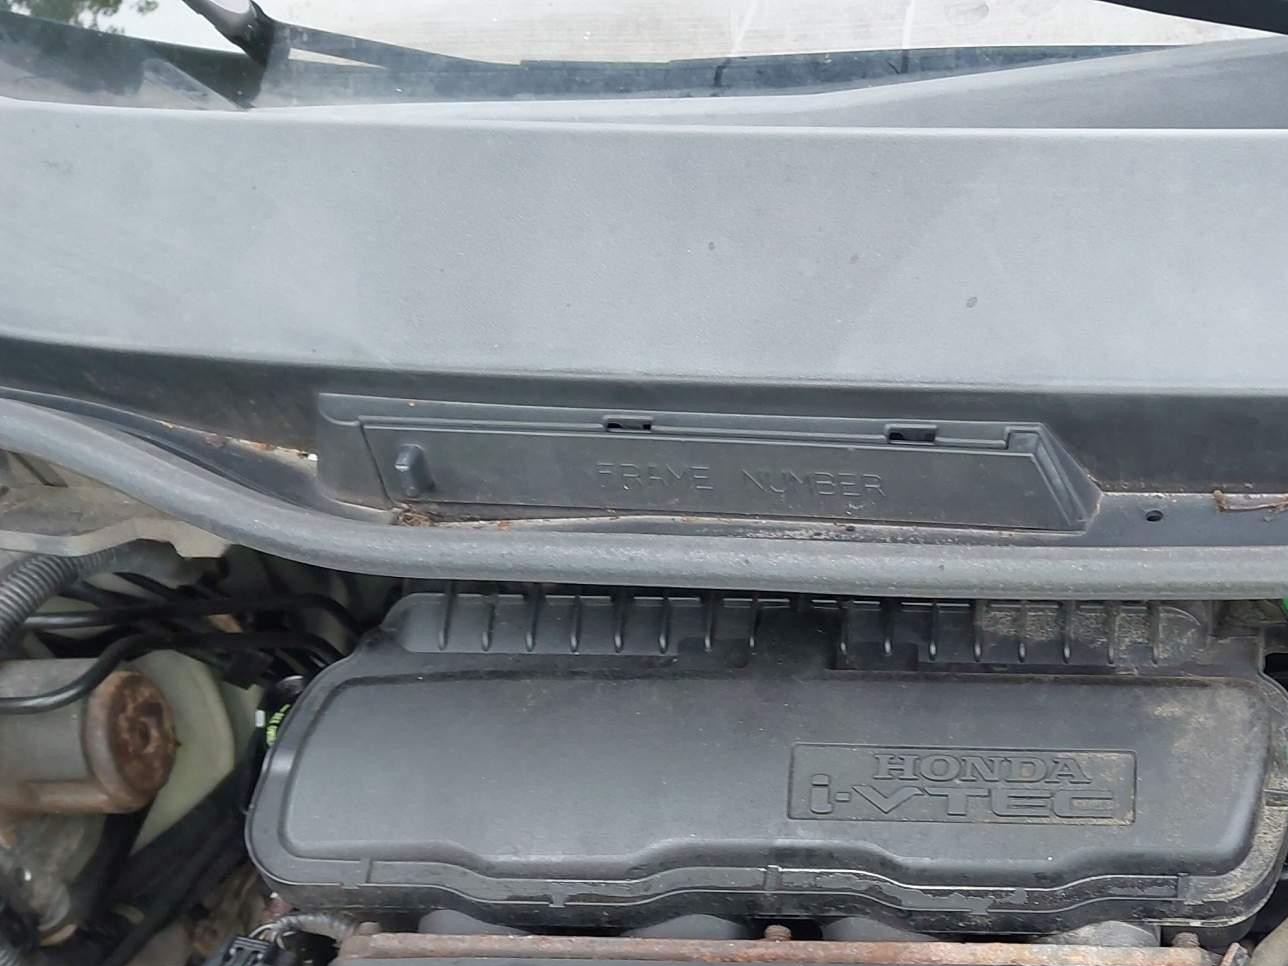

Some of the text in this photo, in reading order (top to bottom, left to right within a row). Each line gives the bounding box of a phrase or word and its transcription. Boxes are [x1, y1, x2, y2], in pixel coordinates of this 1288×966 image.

[596, 461, 887, 497] FRAME NUMBER
[872, 753, 1094, 785] HONDA
[808, 773, 1114, 819] i-VTEC
